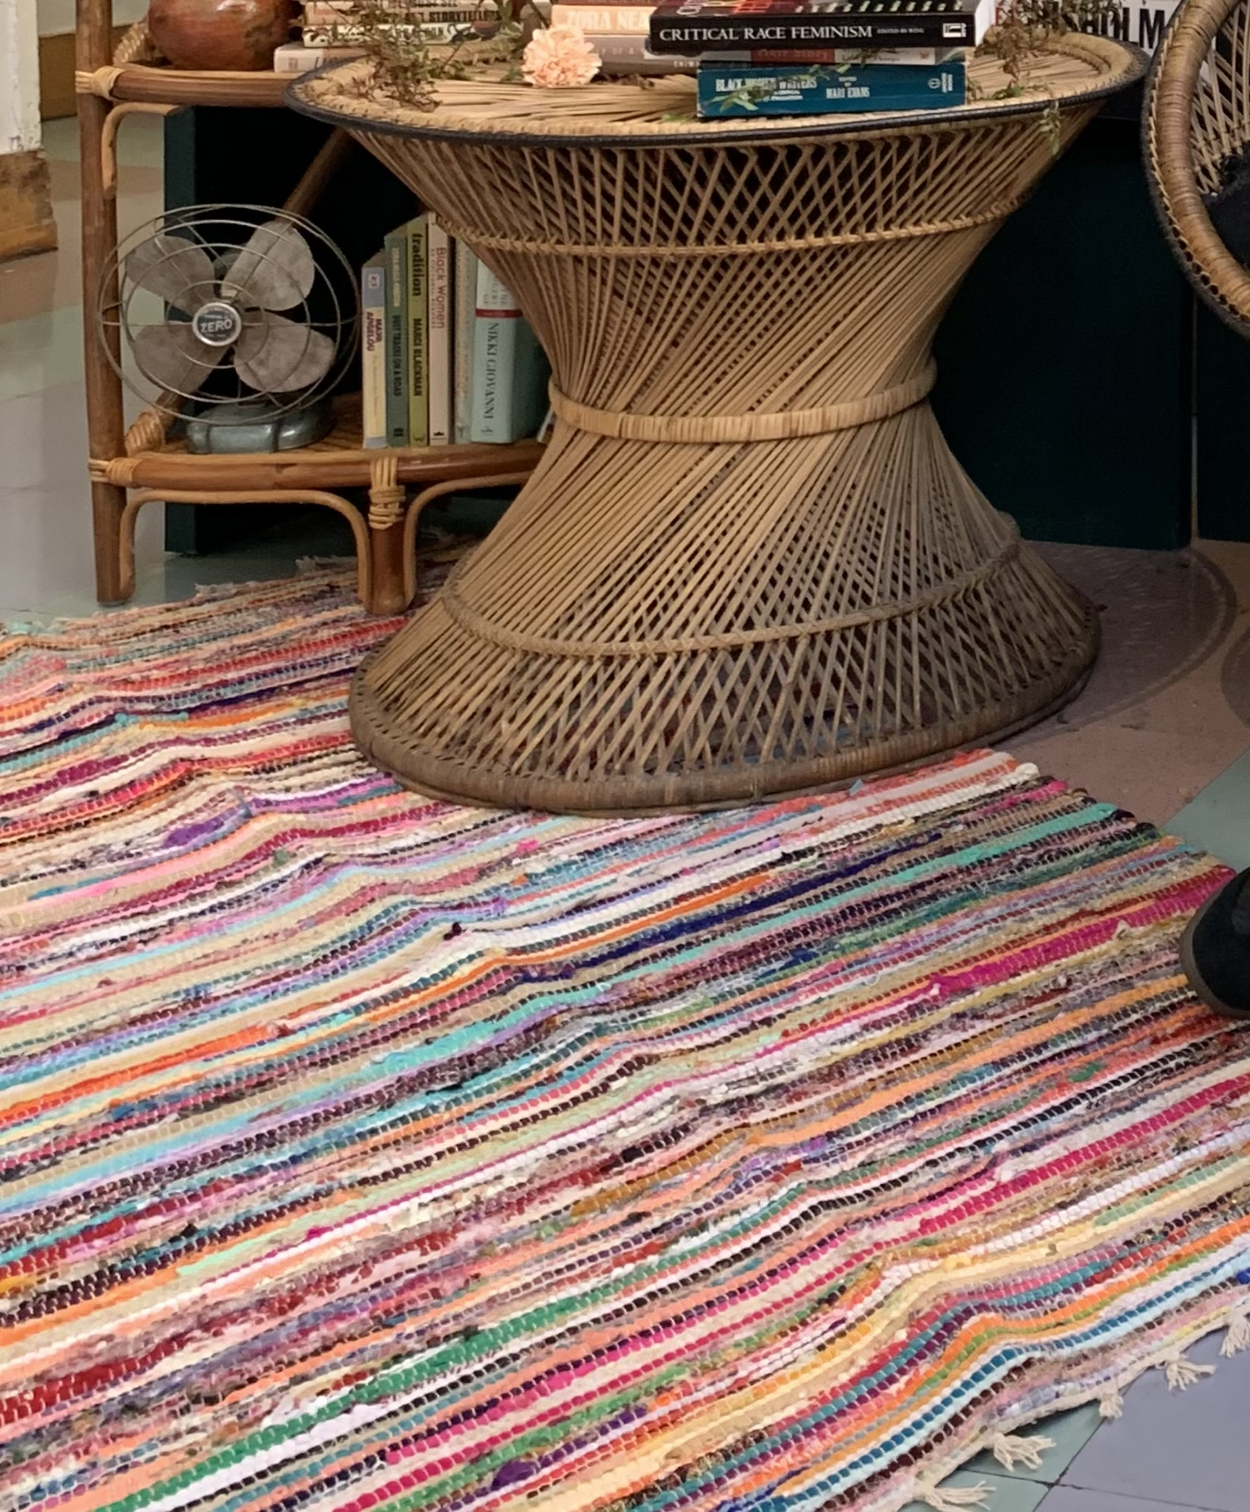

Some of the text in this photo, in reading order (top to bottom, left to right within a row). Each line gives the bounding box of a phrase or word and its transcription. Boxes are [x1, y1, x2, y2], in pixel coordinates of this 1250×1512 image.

[566, 11, 612, 30] ZORA
[660, 25, 873, 41] CRITICAL RACE FEMINISM
[716, 78, 742, 92] BLACK
[826, 87, 870, 99] MARI EVANS
[436, 247, 448, 329] Black Women
[412, 233, 424, 397] tradition MARCI BLACKMAN
[201, 319, 233, 333] ZERO
[366, 311, 375, 352] ANGELOU
[374, 318, 383, 343] MAYA
[484, 323, 499, 419] NIKKI GIOVANNI
[394, 376, 402, 397] ROAD
